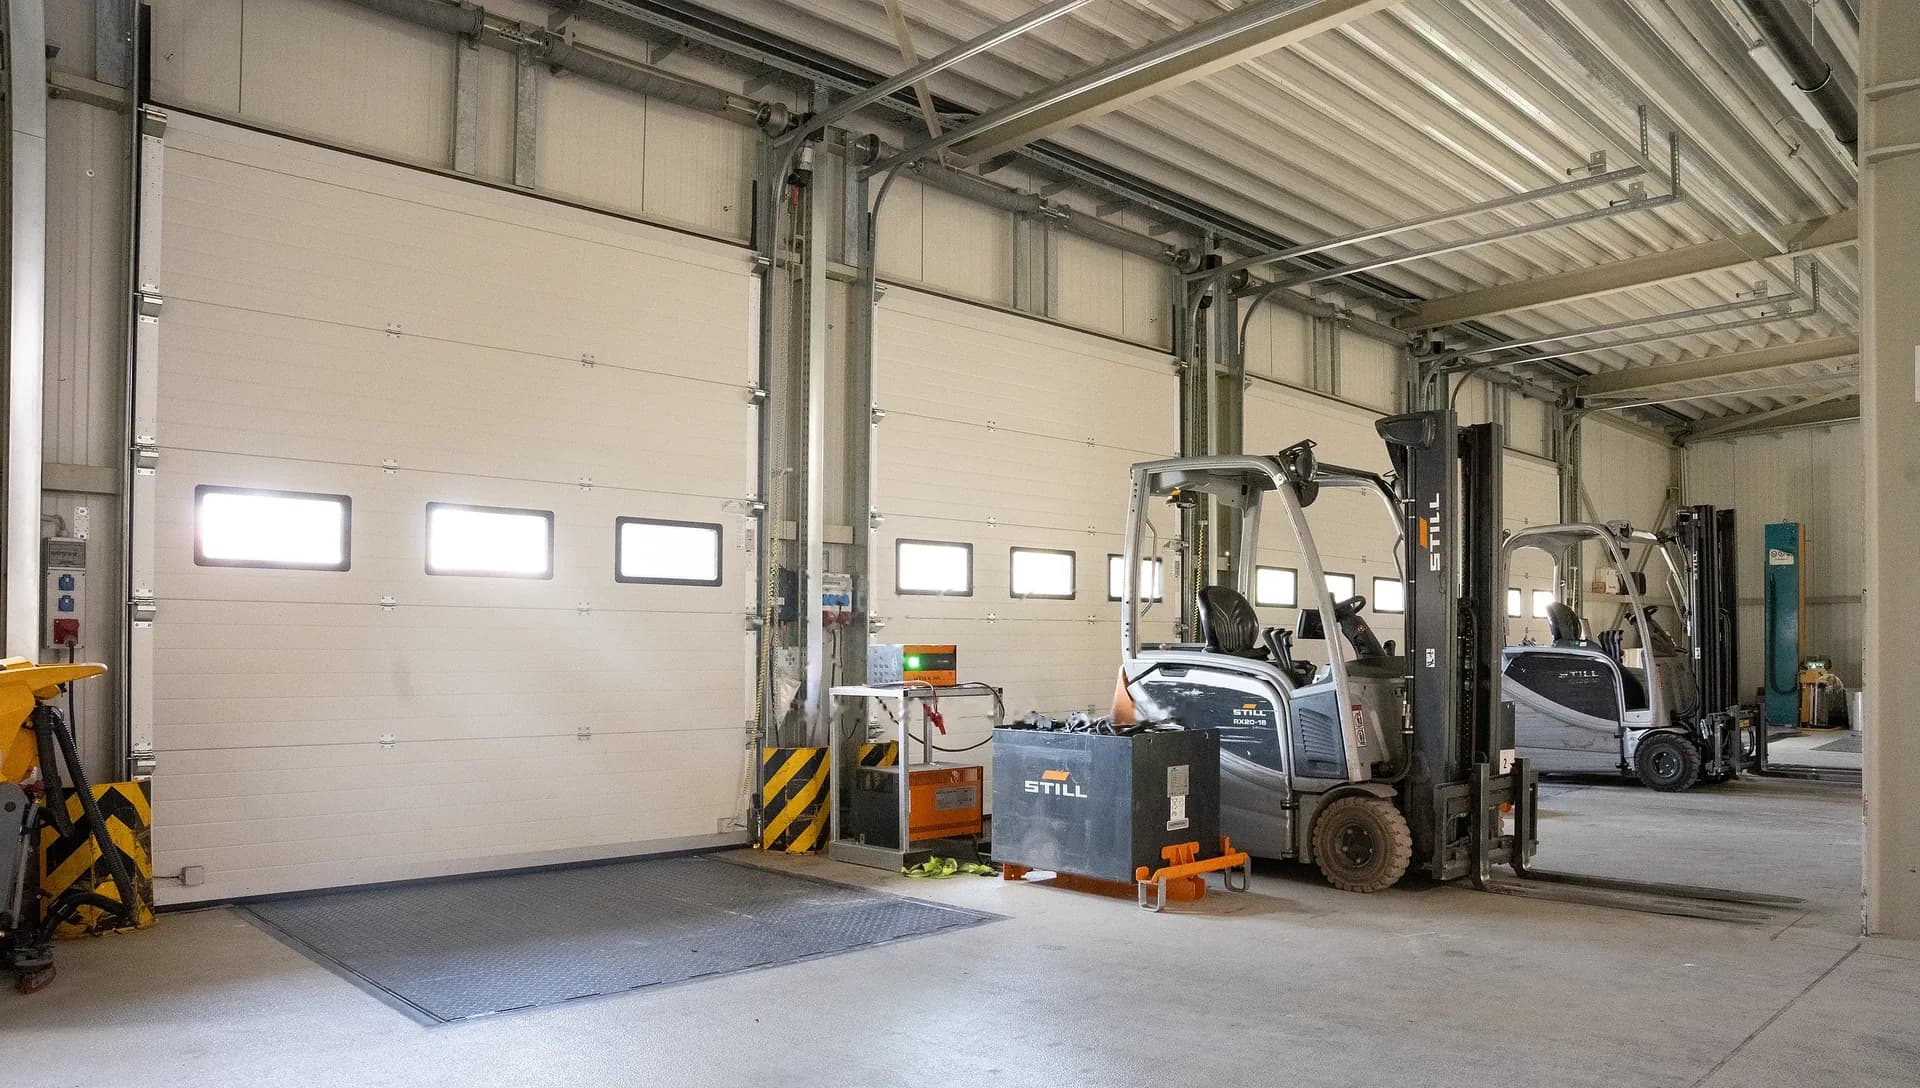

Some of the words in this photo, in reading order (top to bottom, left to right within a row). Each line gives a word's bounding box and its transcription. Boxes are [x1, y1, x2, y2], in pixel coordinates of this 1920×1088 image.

[1429, 493, 1440, 571] STILL
[1233, 708, 1267, 717] STILL
[1503, 758, 1507, 769] 2
[1024, 780, 1088, 799] STILL
